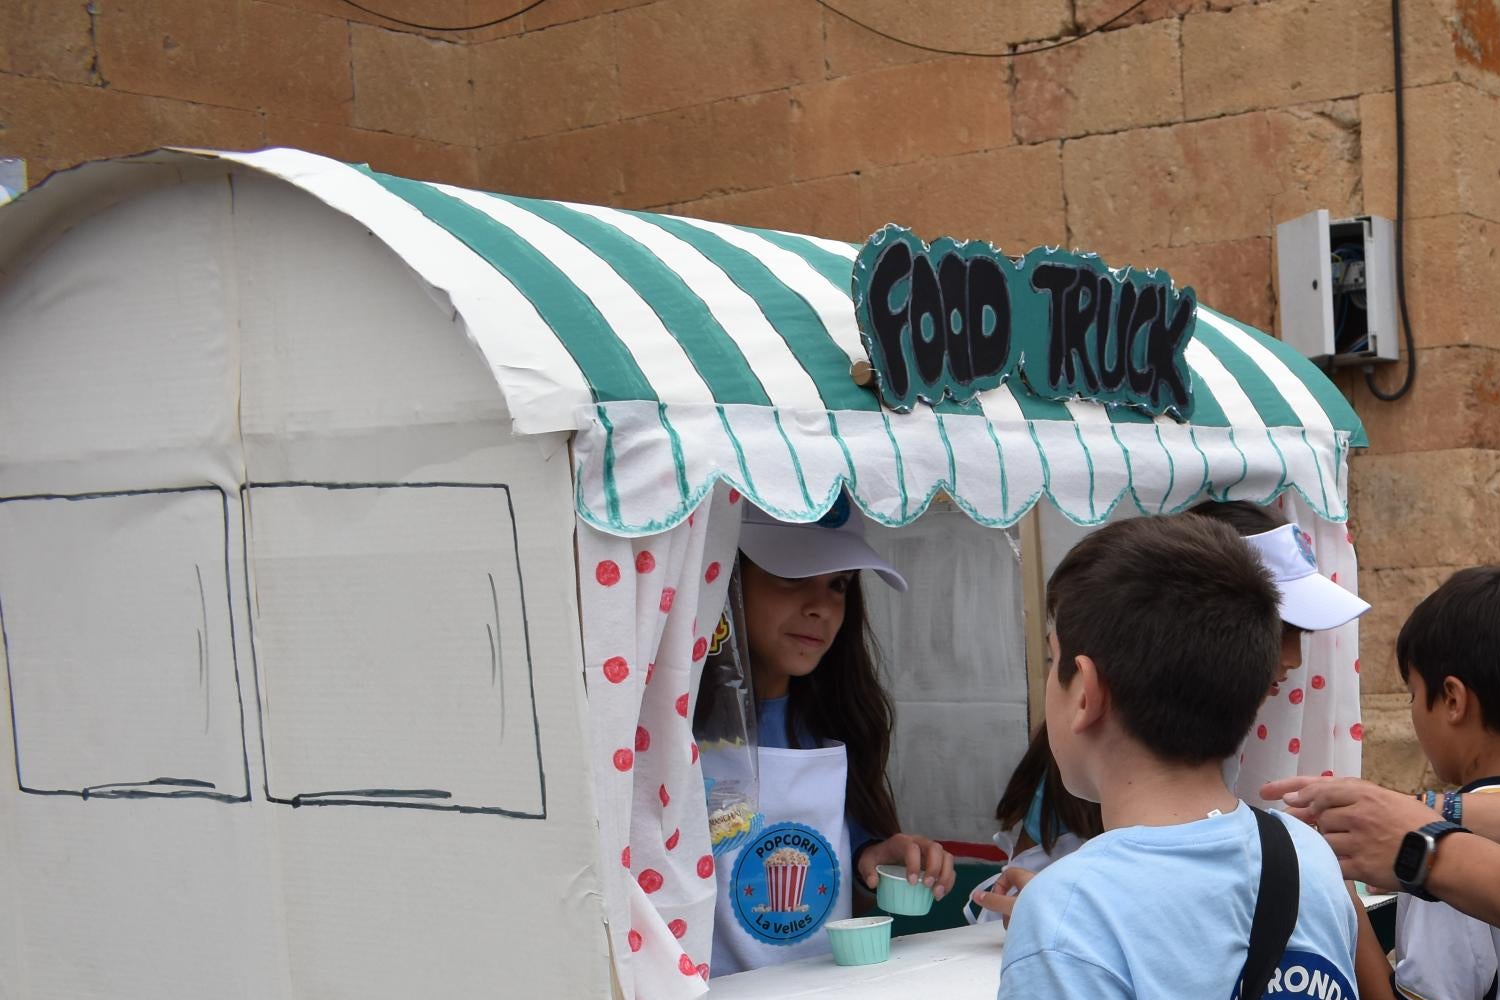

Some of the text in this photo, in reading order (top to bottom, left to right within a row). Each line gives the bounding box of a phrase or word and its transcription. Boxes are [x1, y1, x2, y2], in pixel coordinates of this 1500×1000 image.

[868, 238, 1196, 408] FOOD TRUCK
[755, 834, 819, 858] POPCORN
[755, 914, 770, 930] La
